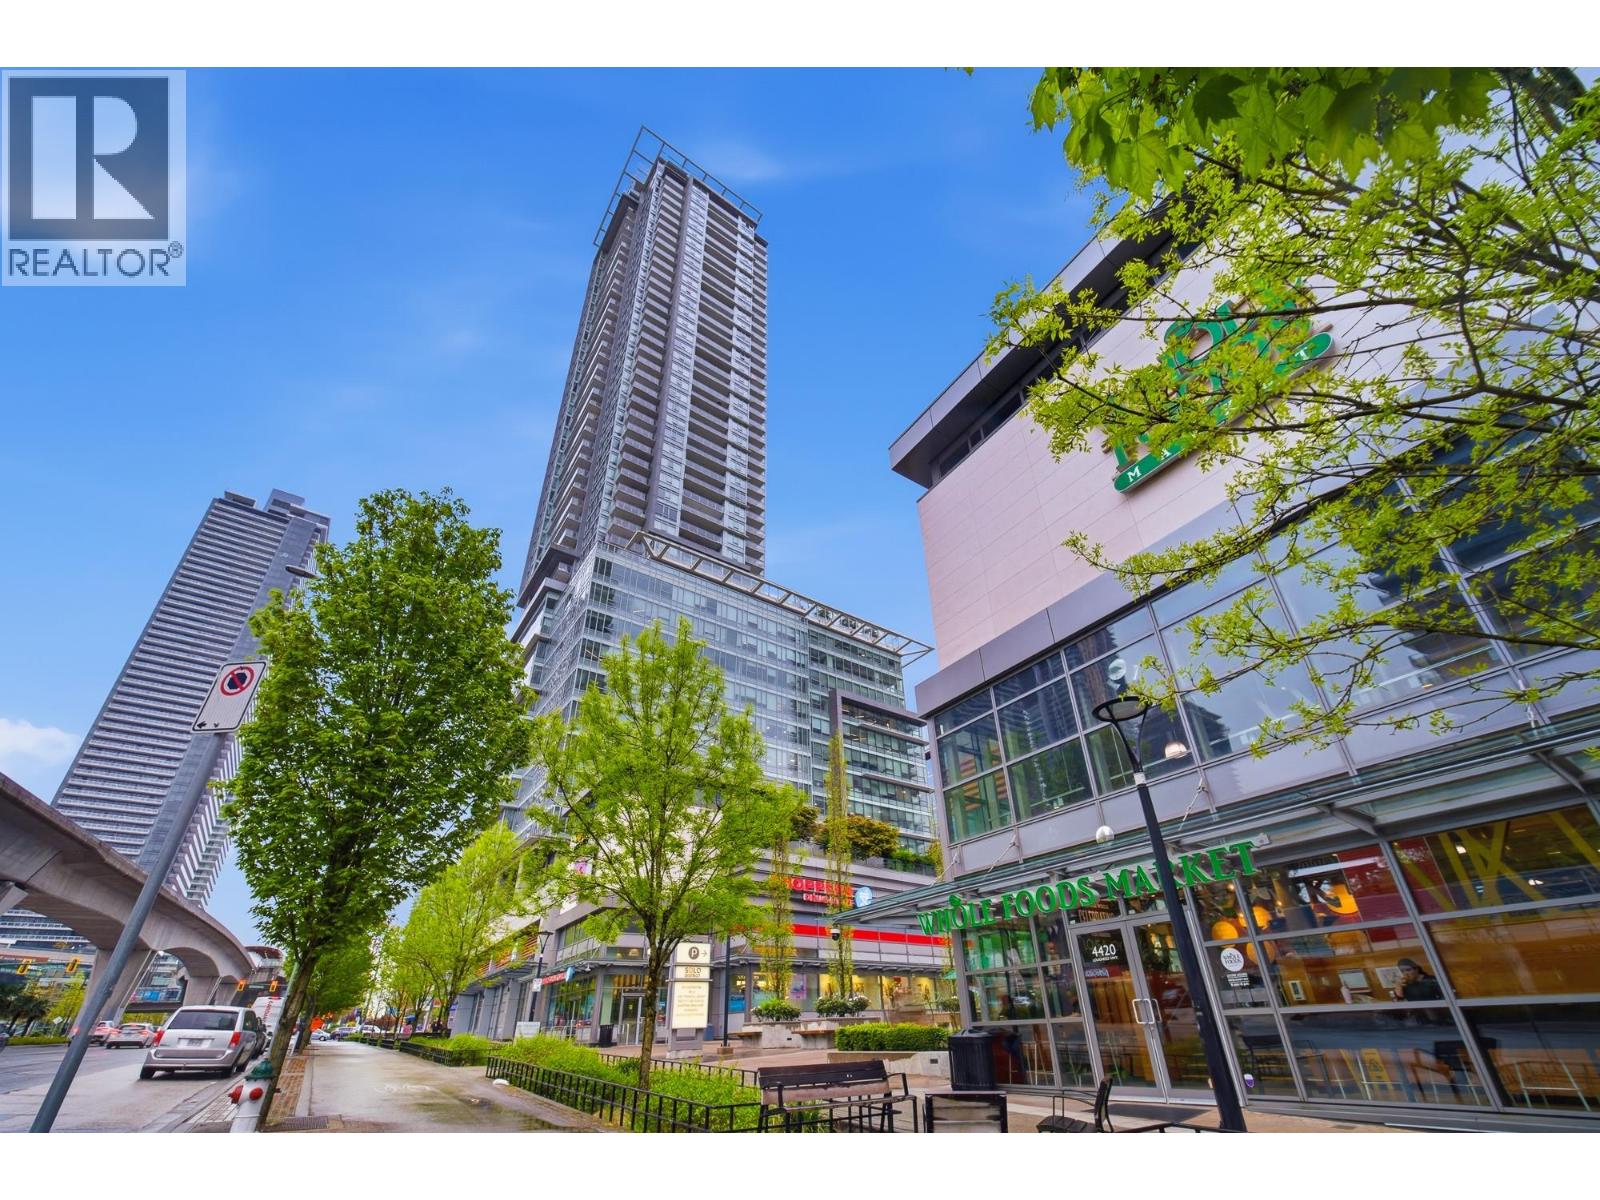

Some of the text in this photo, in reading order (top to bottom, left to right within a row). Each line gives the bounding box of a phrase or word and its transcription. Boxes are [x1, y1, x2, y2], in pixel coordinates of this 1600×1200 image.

[916, 894, 997, 936] WHOLE
[1001, 875, 1099, 921] FOODS
[1091, 943, 1117, 957] 4420
